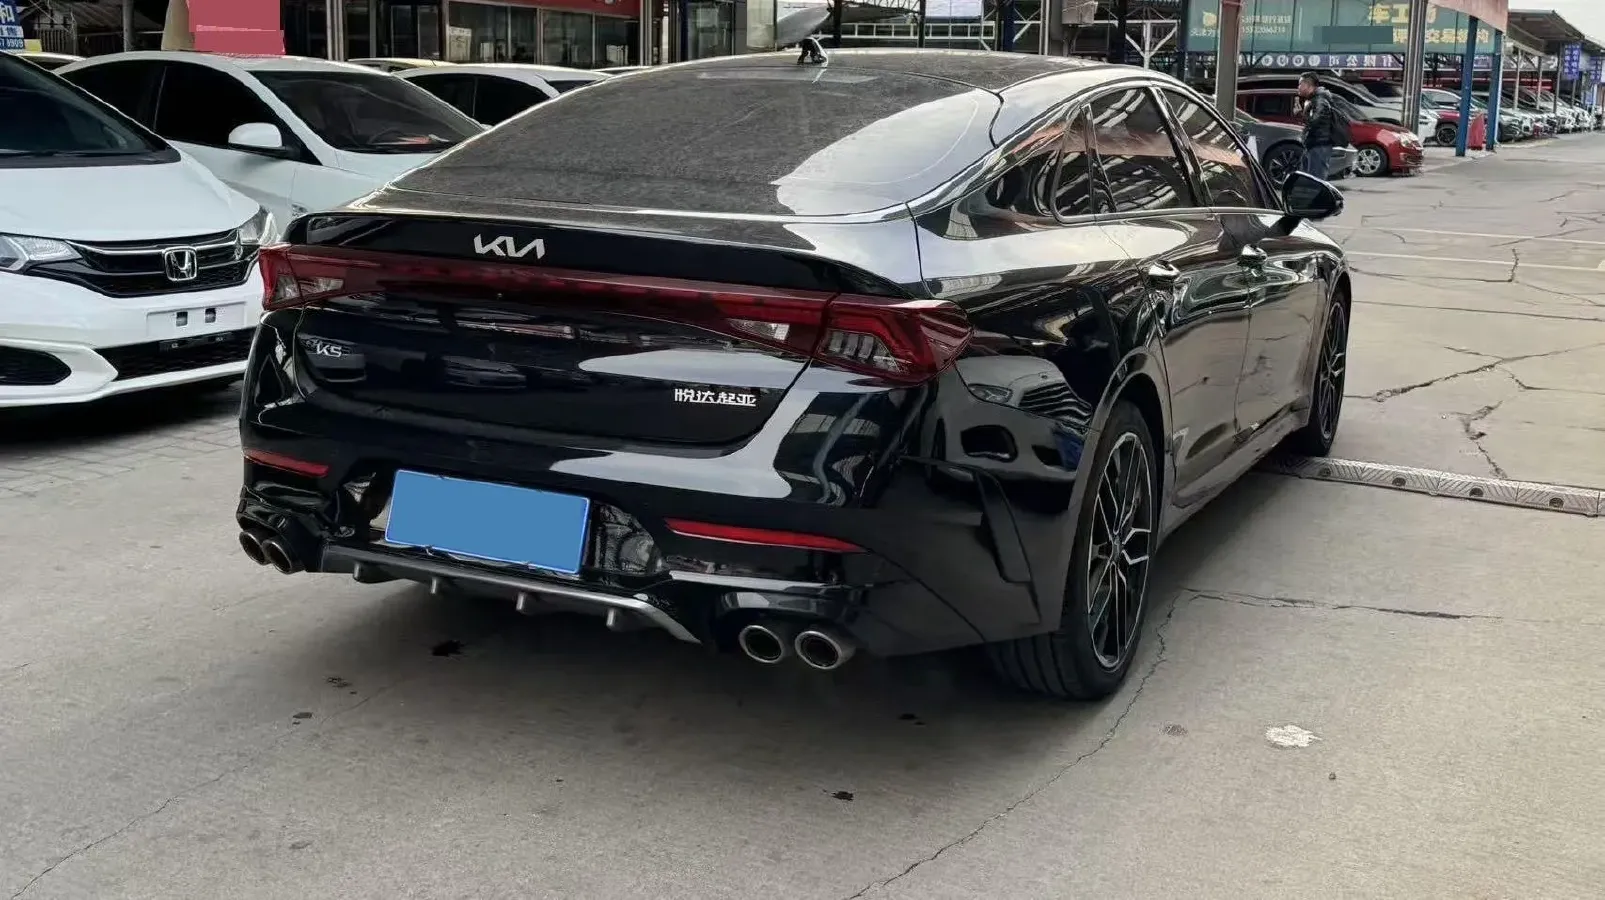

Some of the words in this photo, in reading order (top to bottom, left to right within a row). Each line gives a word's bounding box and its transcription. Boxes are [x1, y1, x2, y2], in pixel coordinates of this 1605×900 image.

[473, 234, 546, 260] KIA
[316, 341, 342, 358] K5
[674, 388, 757, 407] 悦达起亚
